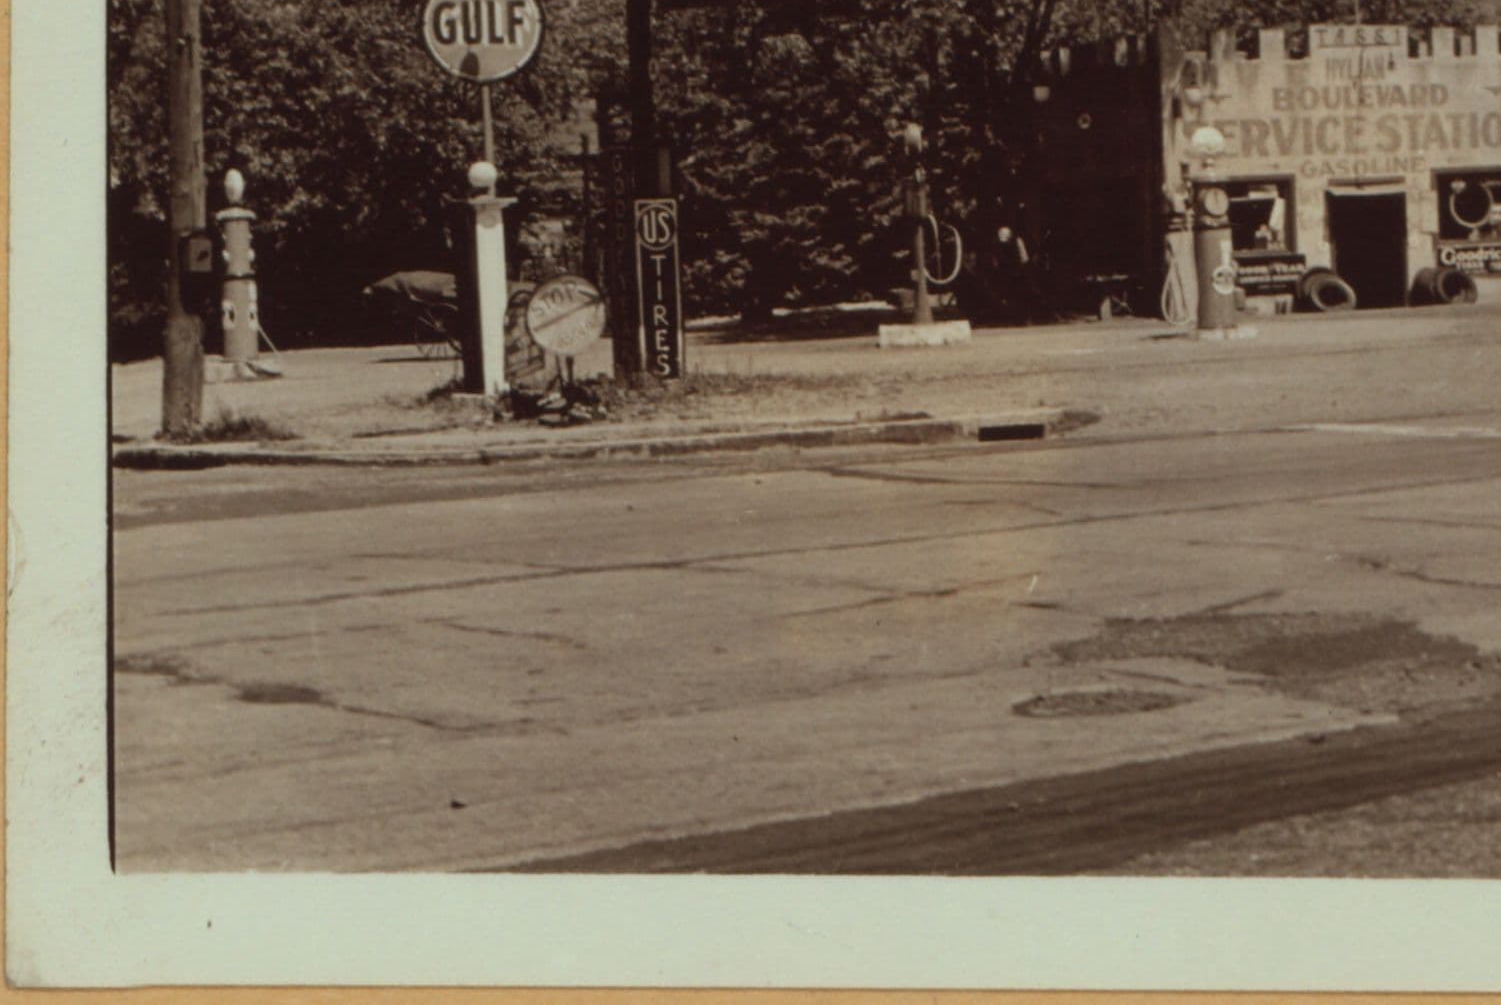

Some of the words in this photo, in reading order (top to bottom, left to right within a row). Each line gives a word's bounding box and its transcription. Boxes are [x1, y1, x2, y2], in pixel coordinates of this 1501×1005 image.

[1272, 81, 1450, 112] BOULEVARD
[1301, 155, 1427, 180] GASOLINE
[642, 209, 671, 244] US
[651, 254, 672, 377] TIRES
